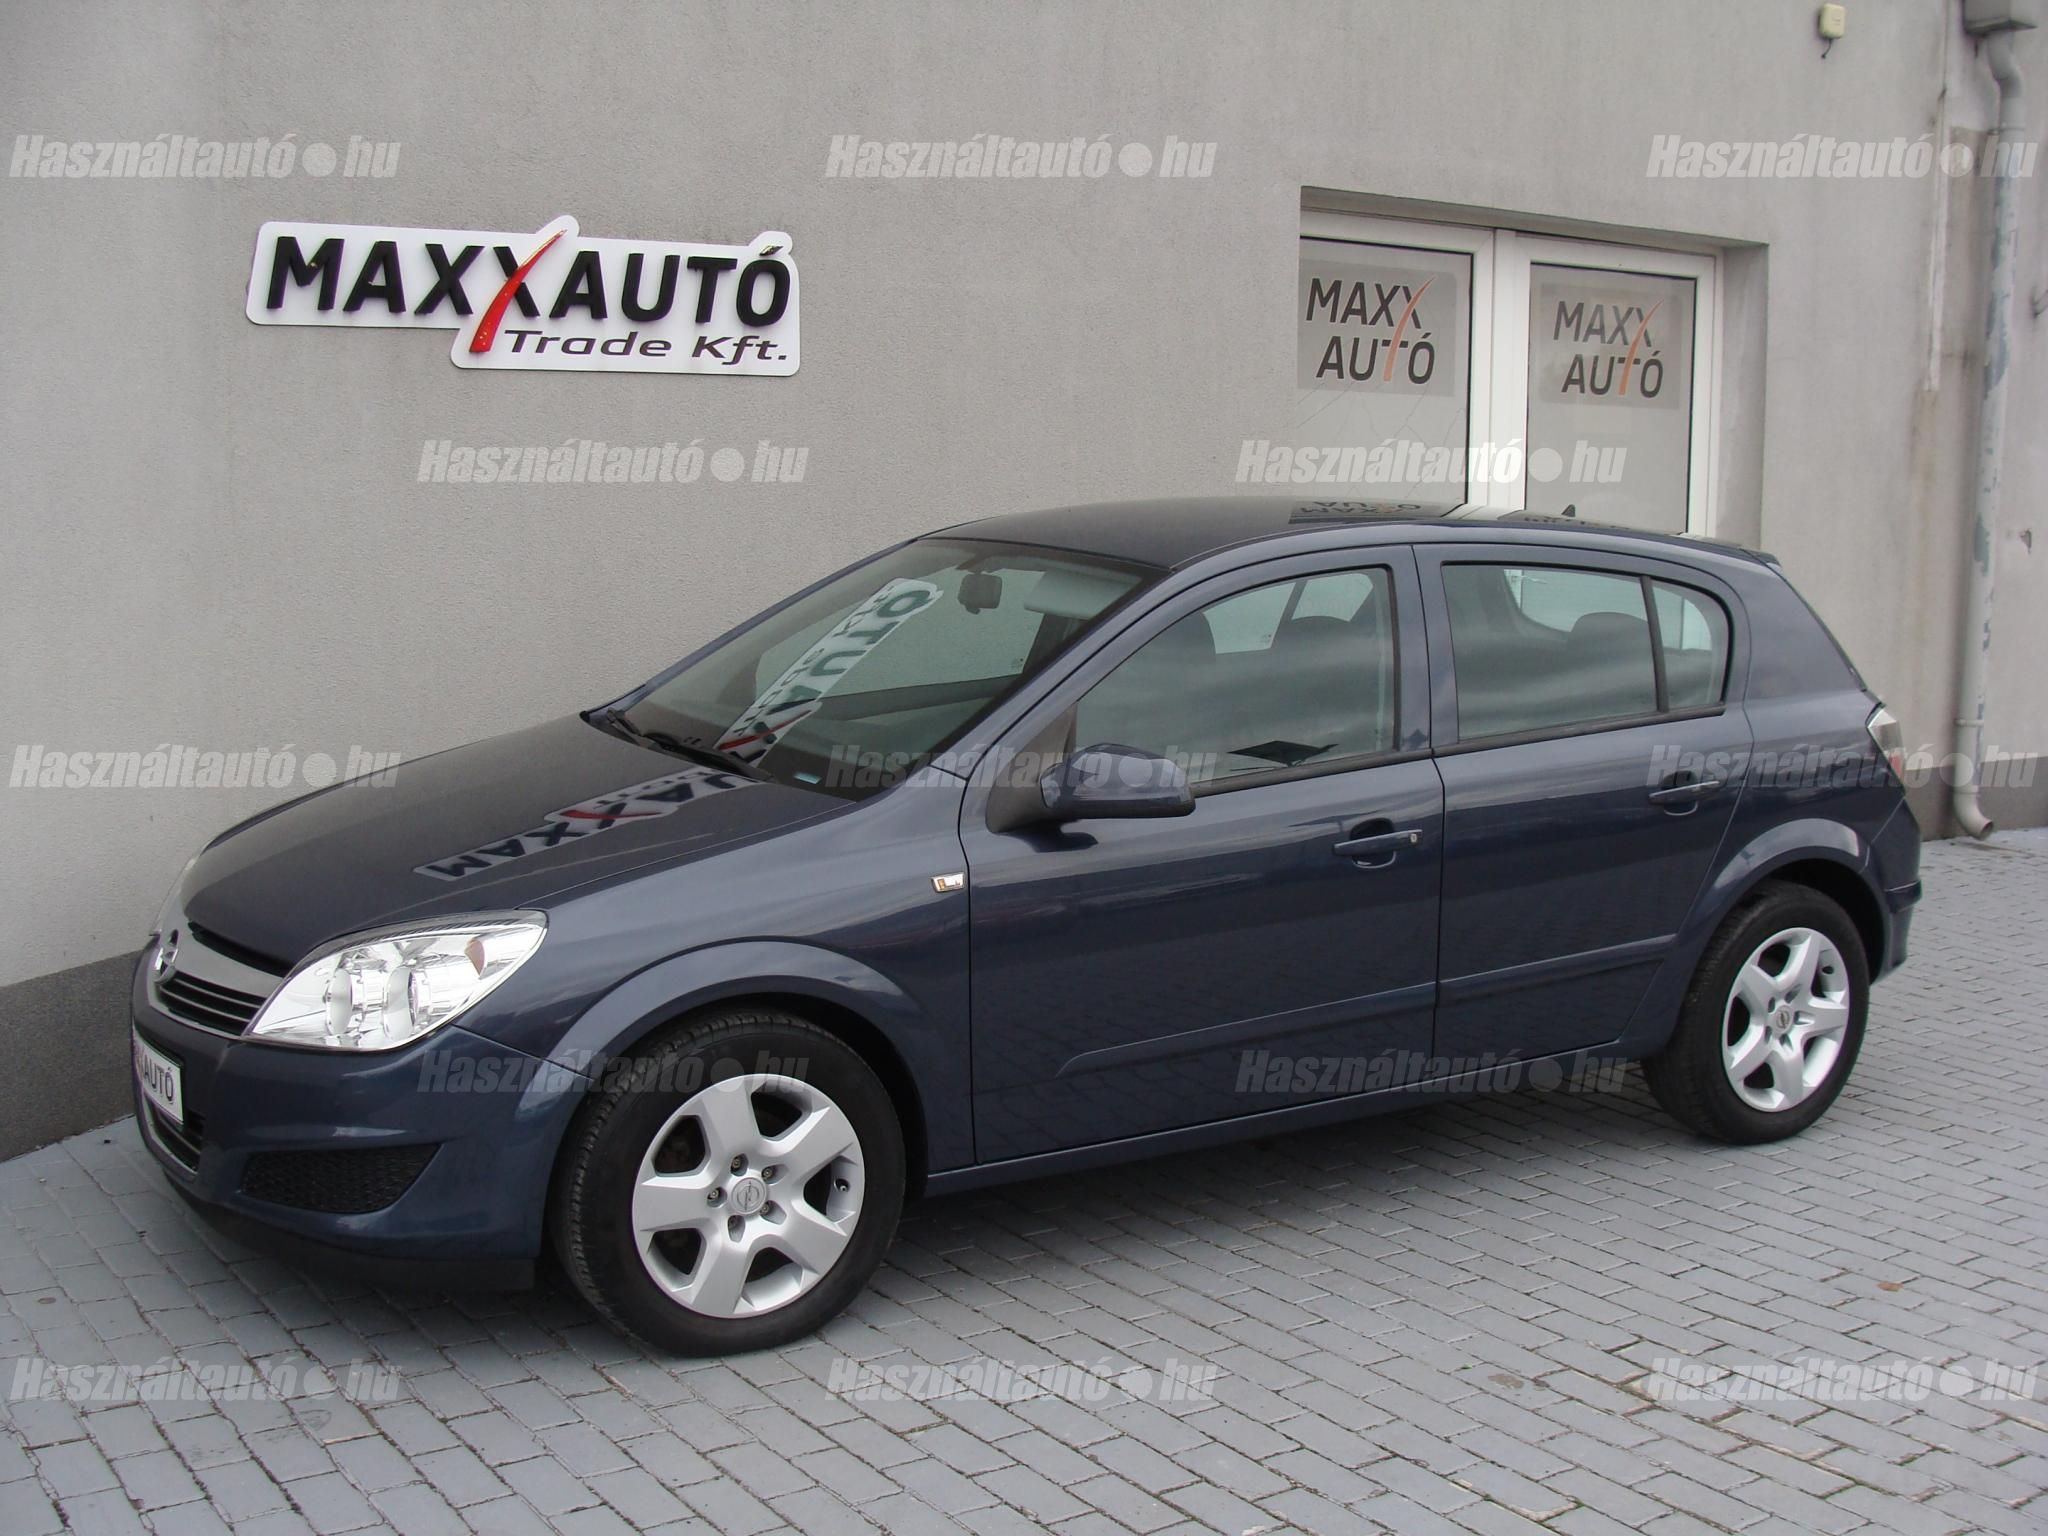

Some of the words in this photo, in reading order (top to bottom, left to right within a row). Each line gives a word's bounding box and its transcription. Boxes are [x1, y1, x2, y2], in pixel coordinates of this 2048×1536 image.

[1306, 276, 1436, 329] MAXX
[1553, 300, 1664, 348] MAXX
[503, 329, 672, 357] Trade
[692, 335, 788, 366] Kft.
[1316, 332, 1435, 384] AUTÓ
[1561, 350, 1664, 398] AUTÓ
